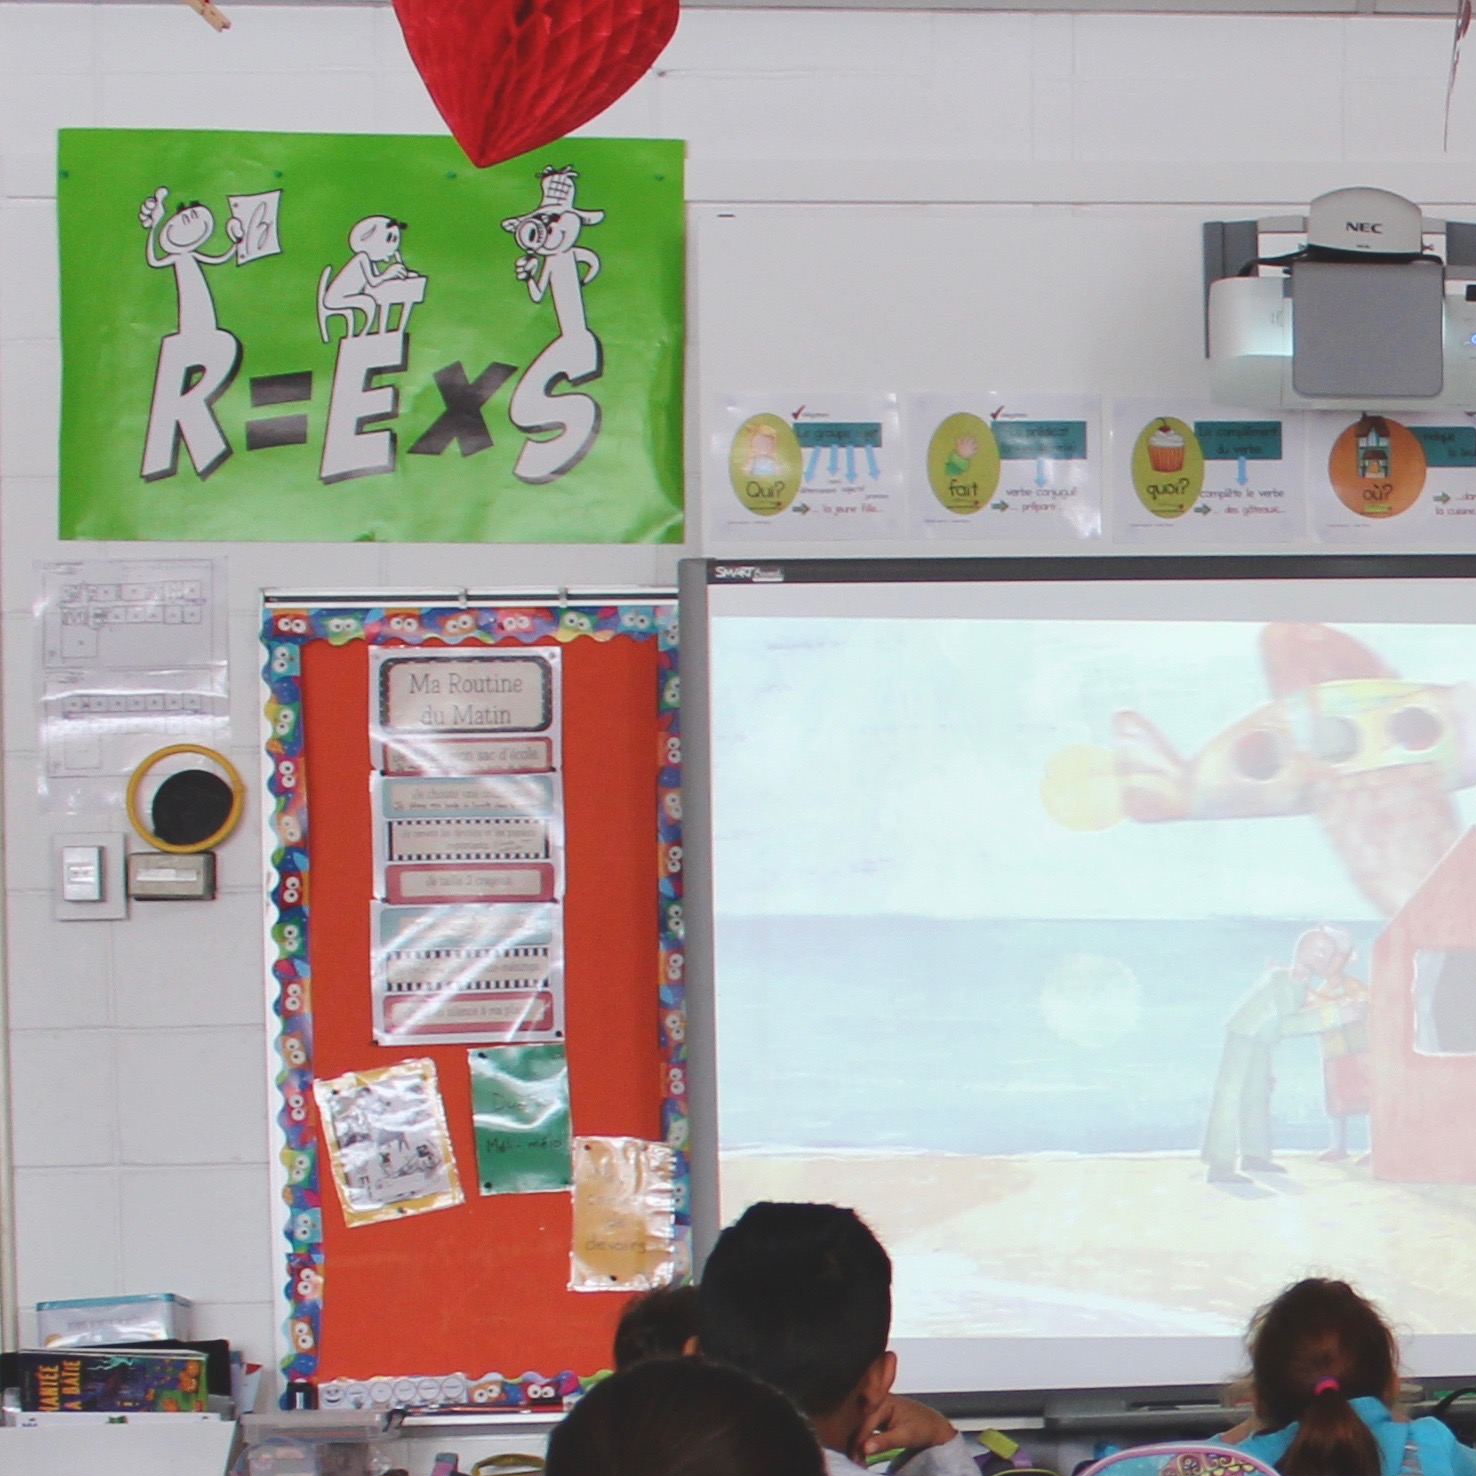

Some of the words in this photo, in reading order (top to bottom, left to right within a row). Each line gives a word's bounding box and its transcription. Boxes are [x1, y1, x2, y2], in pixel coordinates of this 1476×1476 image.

[1346, 222, 1382, 233] NEC
[745, 481, 786, 500] Qui?
[949, 481, 979, 497] fait
[1146, 479, 1190, 500] quoi?
[1245, 488, 1255, 498] le
[1258, 488, 1284, 498] verbe
[715, 565, 754, 578] SMART
[410, 673, 440, 694] Ma
[449, 672, 522, 693] Routine
[422, 705, 445, 725] du
[453, 704, 511, 725] Matin
